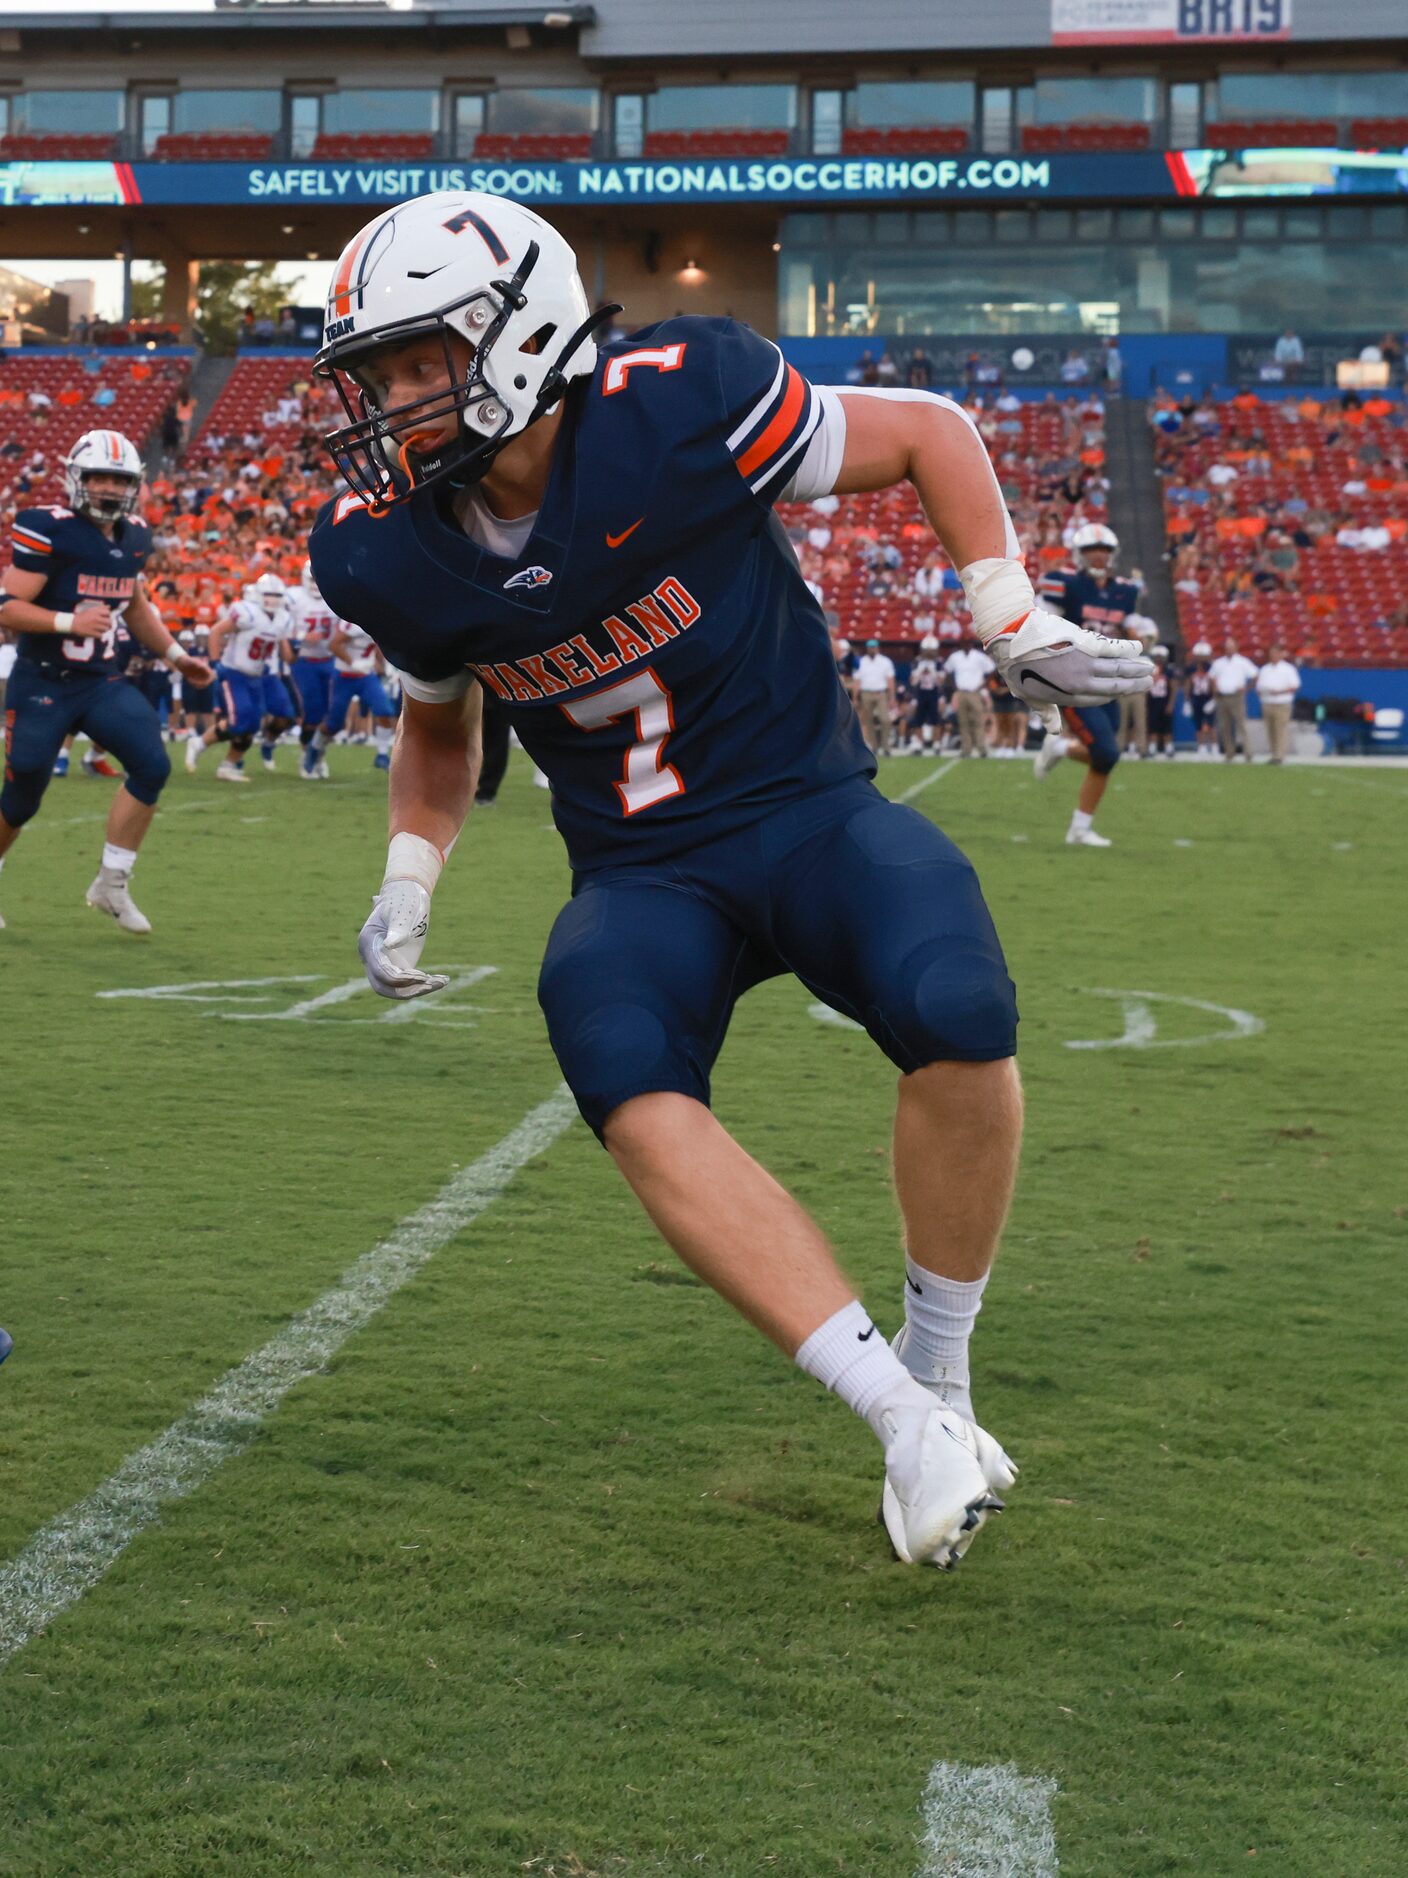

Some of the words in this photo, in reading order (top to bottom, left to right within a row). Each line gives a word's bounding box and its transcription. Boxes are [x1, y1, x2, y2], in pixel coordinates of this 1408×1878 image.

[249, 168, 350, 196] SAFELY
[355, 168, 425, 195] VISIT
[429, 169, 466, 193] US
[470, 168, 563, 196] SOON:
[578, 159, 1050, 195] NATIONALSOCCERHOF.COM
[442, 209, 511, 267] 7
[324, 315, 356, 343] TEAM
[601, 342, 687, 397] 7
[464, 575, 702, 702] WAKELAND
[558, 664, 686, 818] 7
